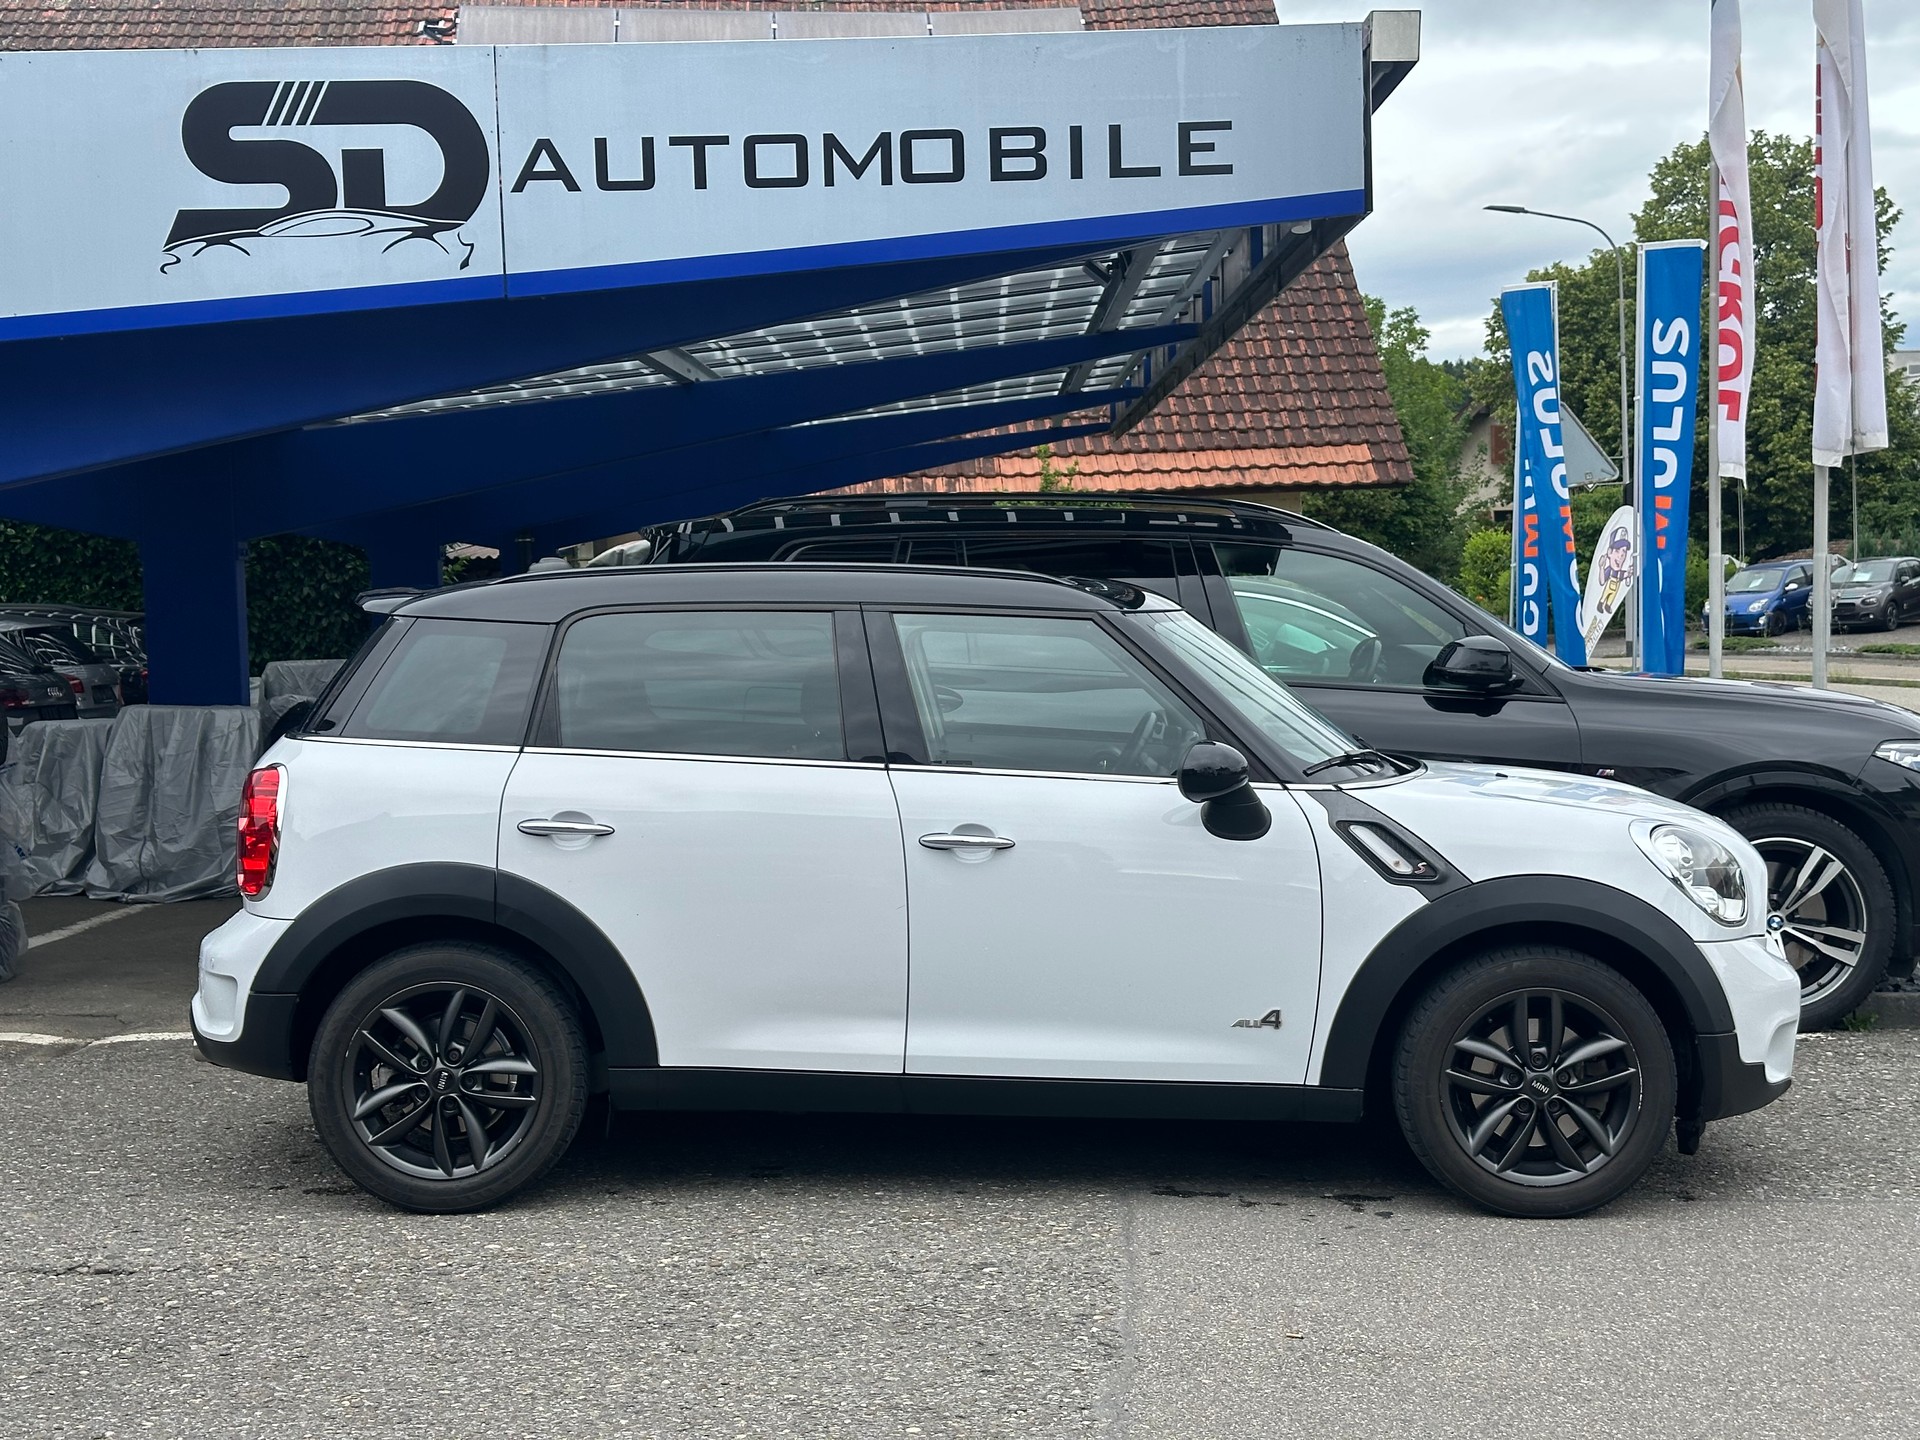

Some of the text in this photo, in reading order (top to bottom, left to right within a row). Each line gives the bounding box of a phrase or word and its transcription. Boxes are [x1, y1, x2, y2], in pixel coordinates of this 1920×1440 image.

[162, 79, 1234, 253] SD AUTOMOBILE
[1414, 861, 1427, 874] S
[1531, 1080, 1549, 1094] MINI
